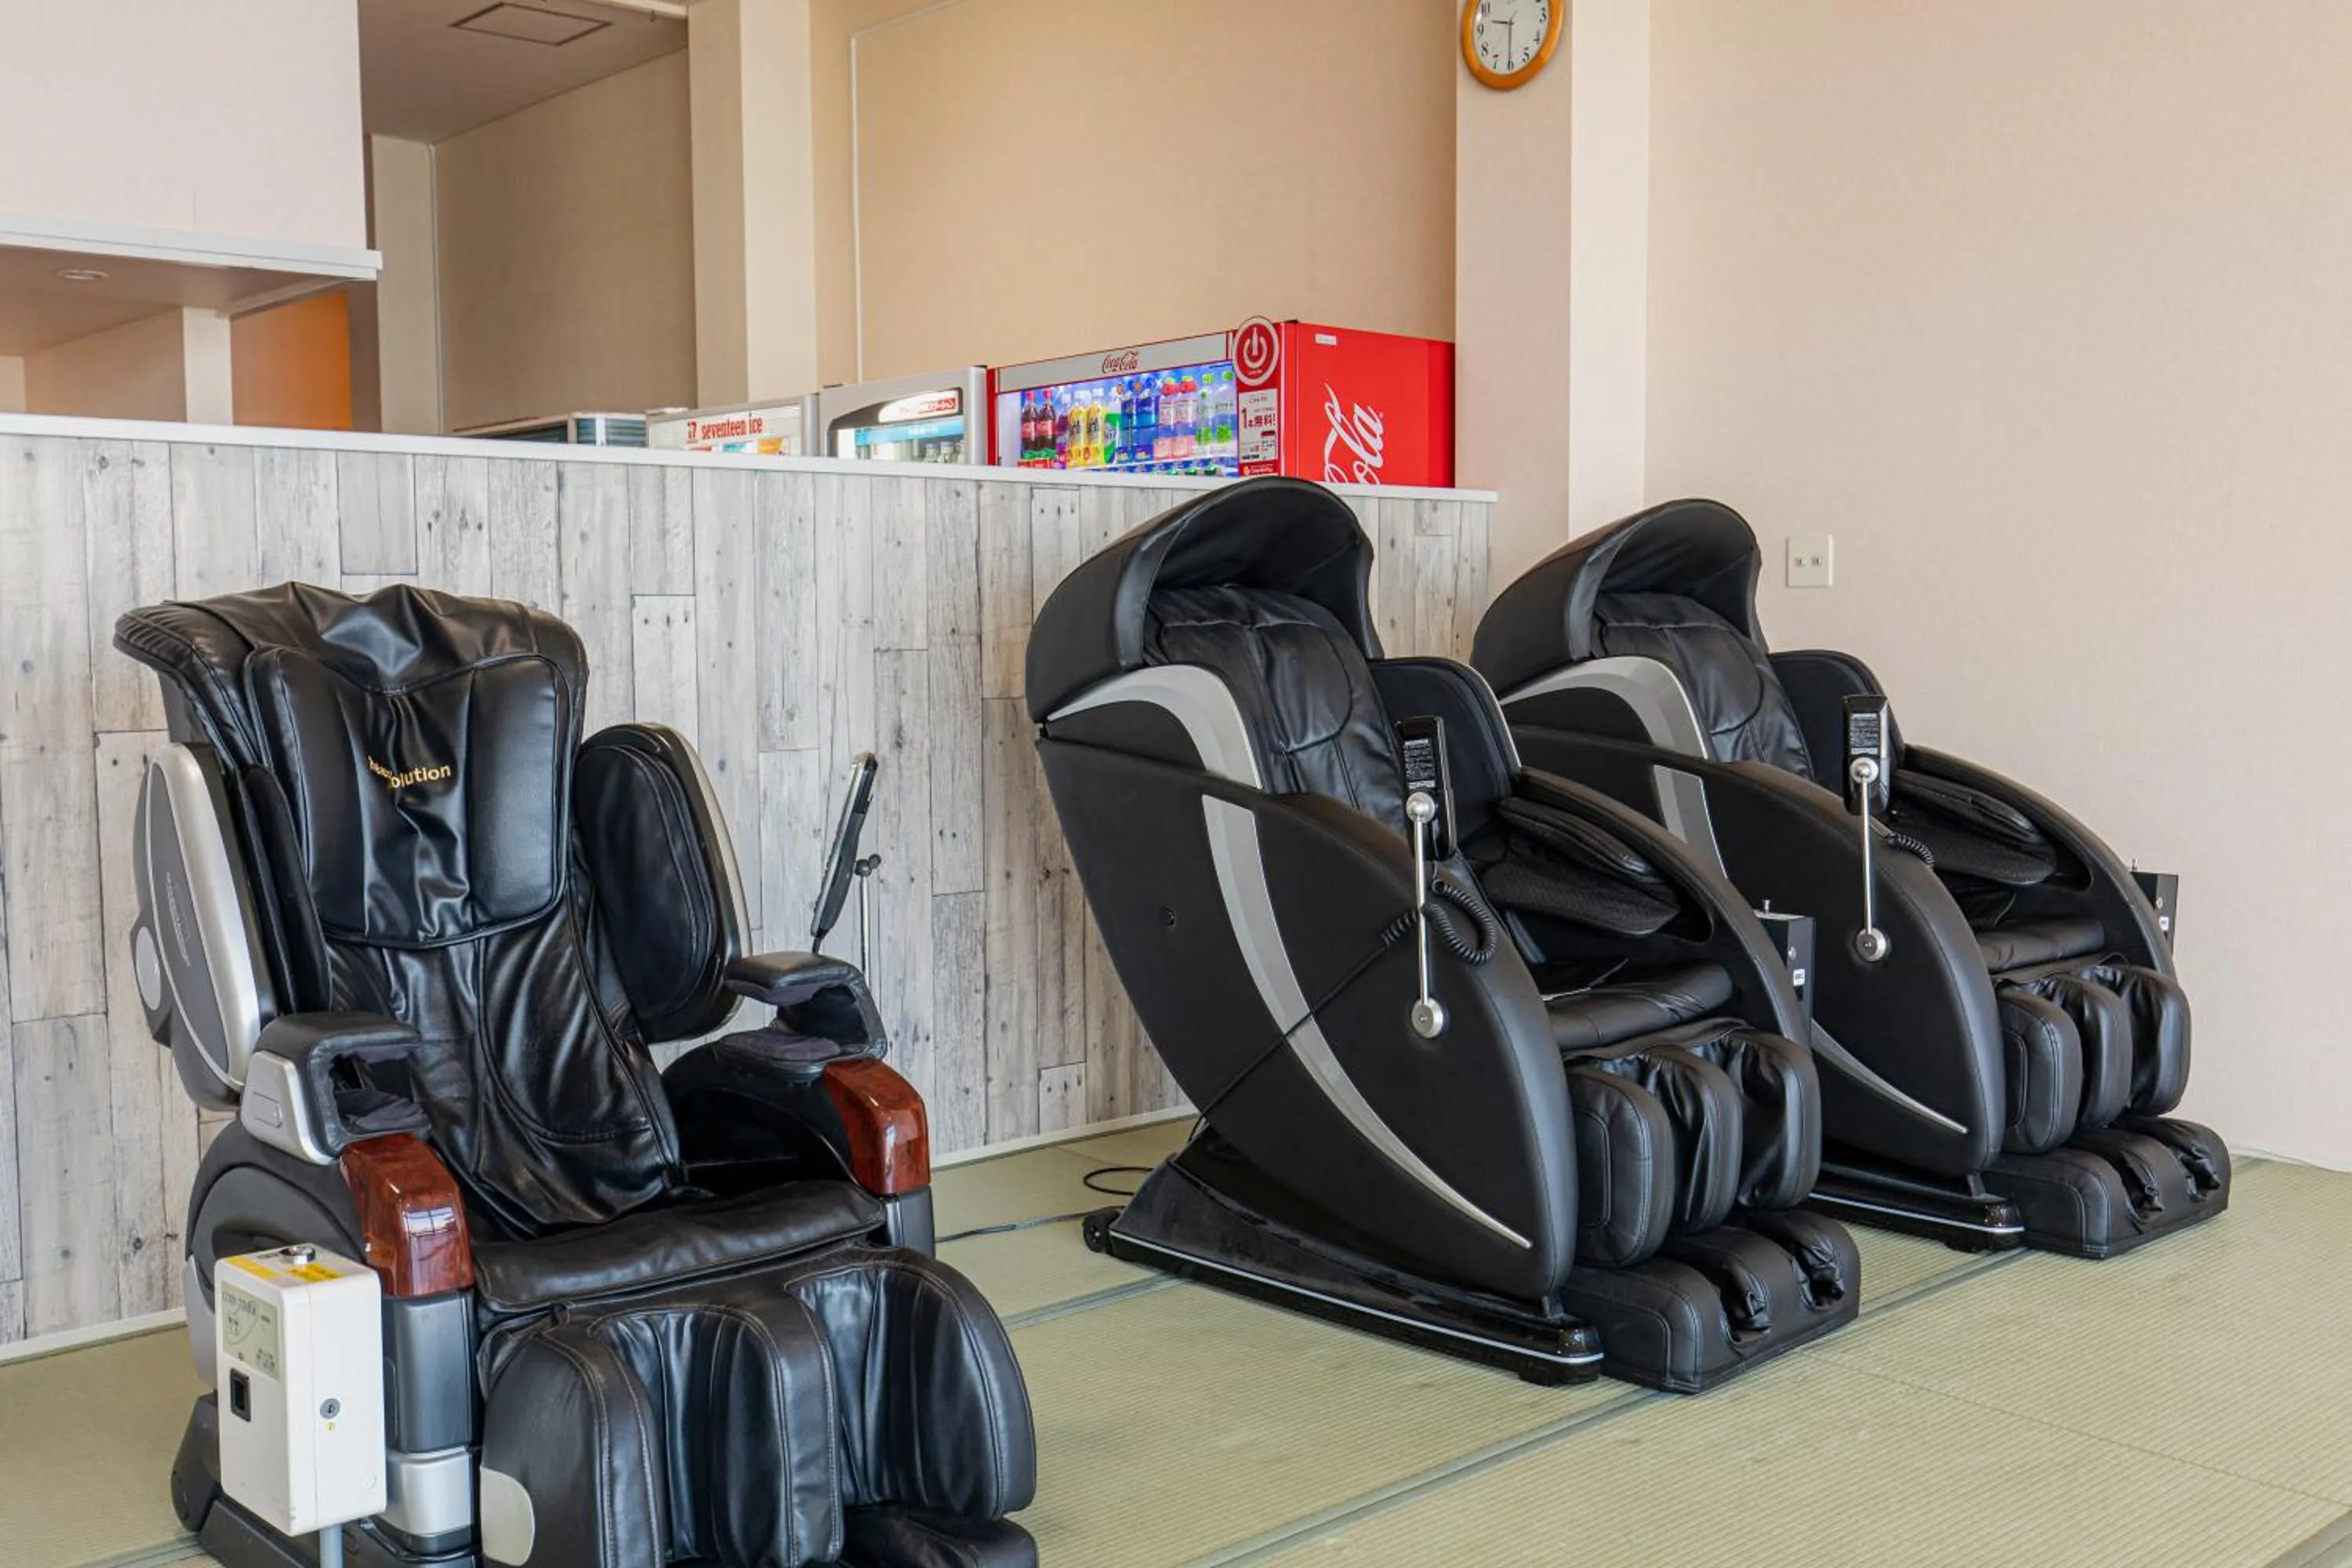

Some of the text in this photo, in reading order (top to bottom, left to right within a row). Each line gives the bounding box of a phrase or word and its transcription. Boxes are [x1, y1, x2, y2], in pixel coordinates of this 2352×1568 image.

[1539, 7, 1547, 23] 3
[1477, 24, 1484, 38] 9
[1533, 29, 1541, 45] 4
[1481, 42, 1489, 57] 8
[1522, 46, 1530, 63] 5
[702, 419, 747, 440] seventeen
[749, 417, 762, 434] ice
